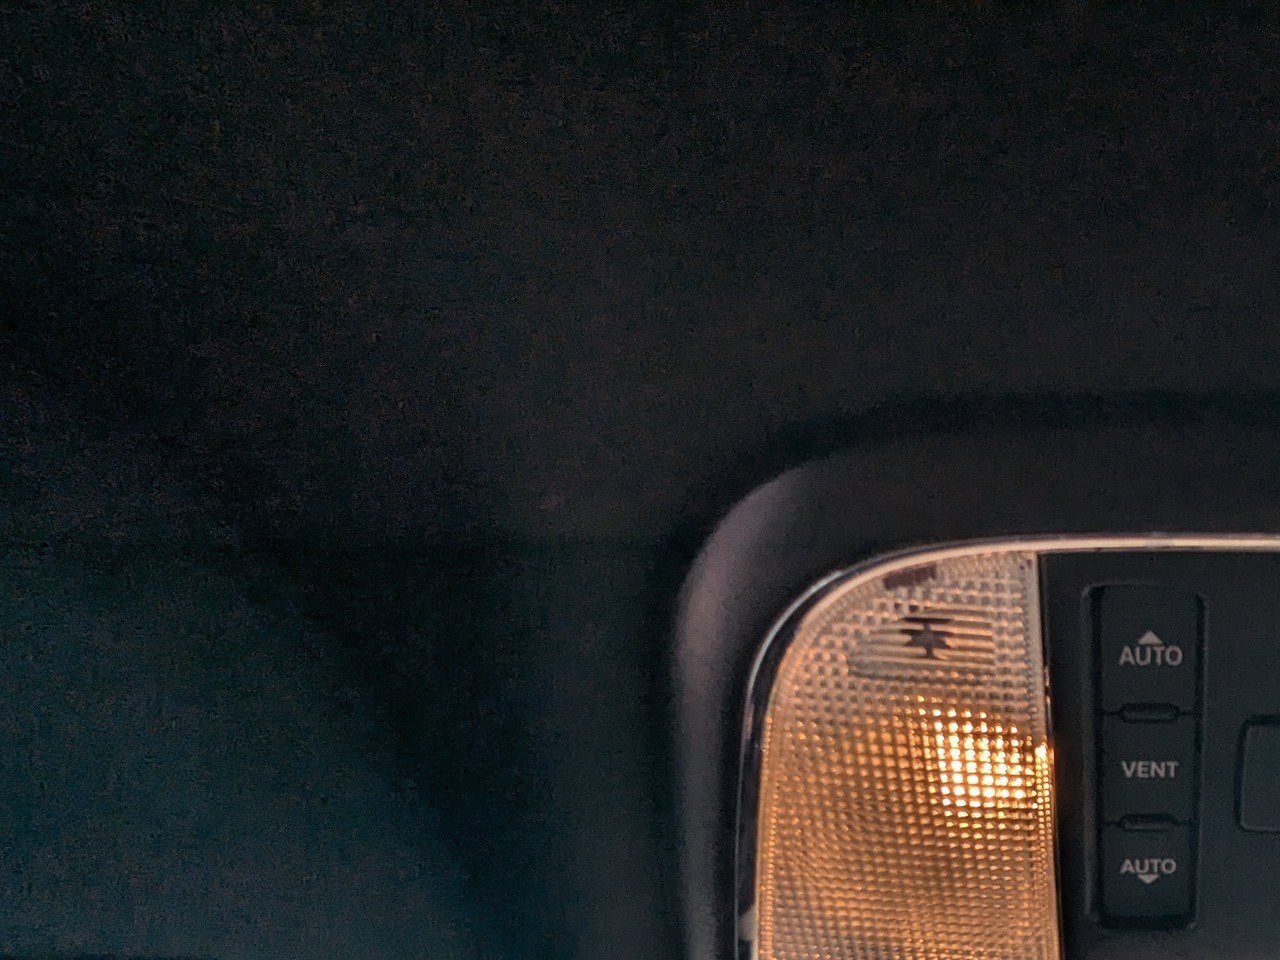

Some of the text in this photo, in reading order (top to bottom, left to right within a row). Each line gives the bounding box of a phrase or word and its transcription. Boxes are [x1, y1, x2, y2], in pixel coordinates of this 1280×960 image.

[1118, 643, 1183, 668] AUTO
[1121, 759, 1179, 780] VENT
[1120, 857, 1177, 877] AUTO
